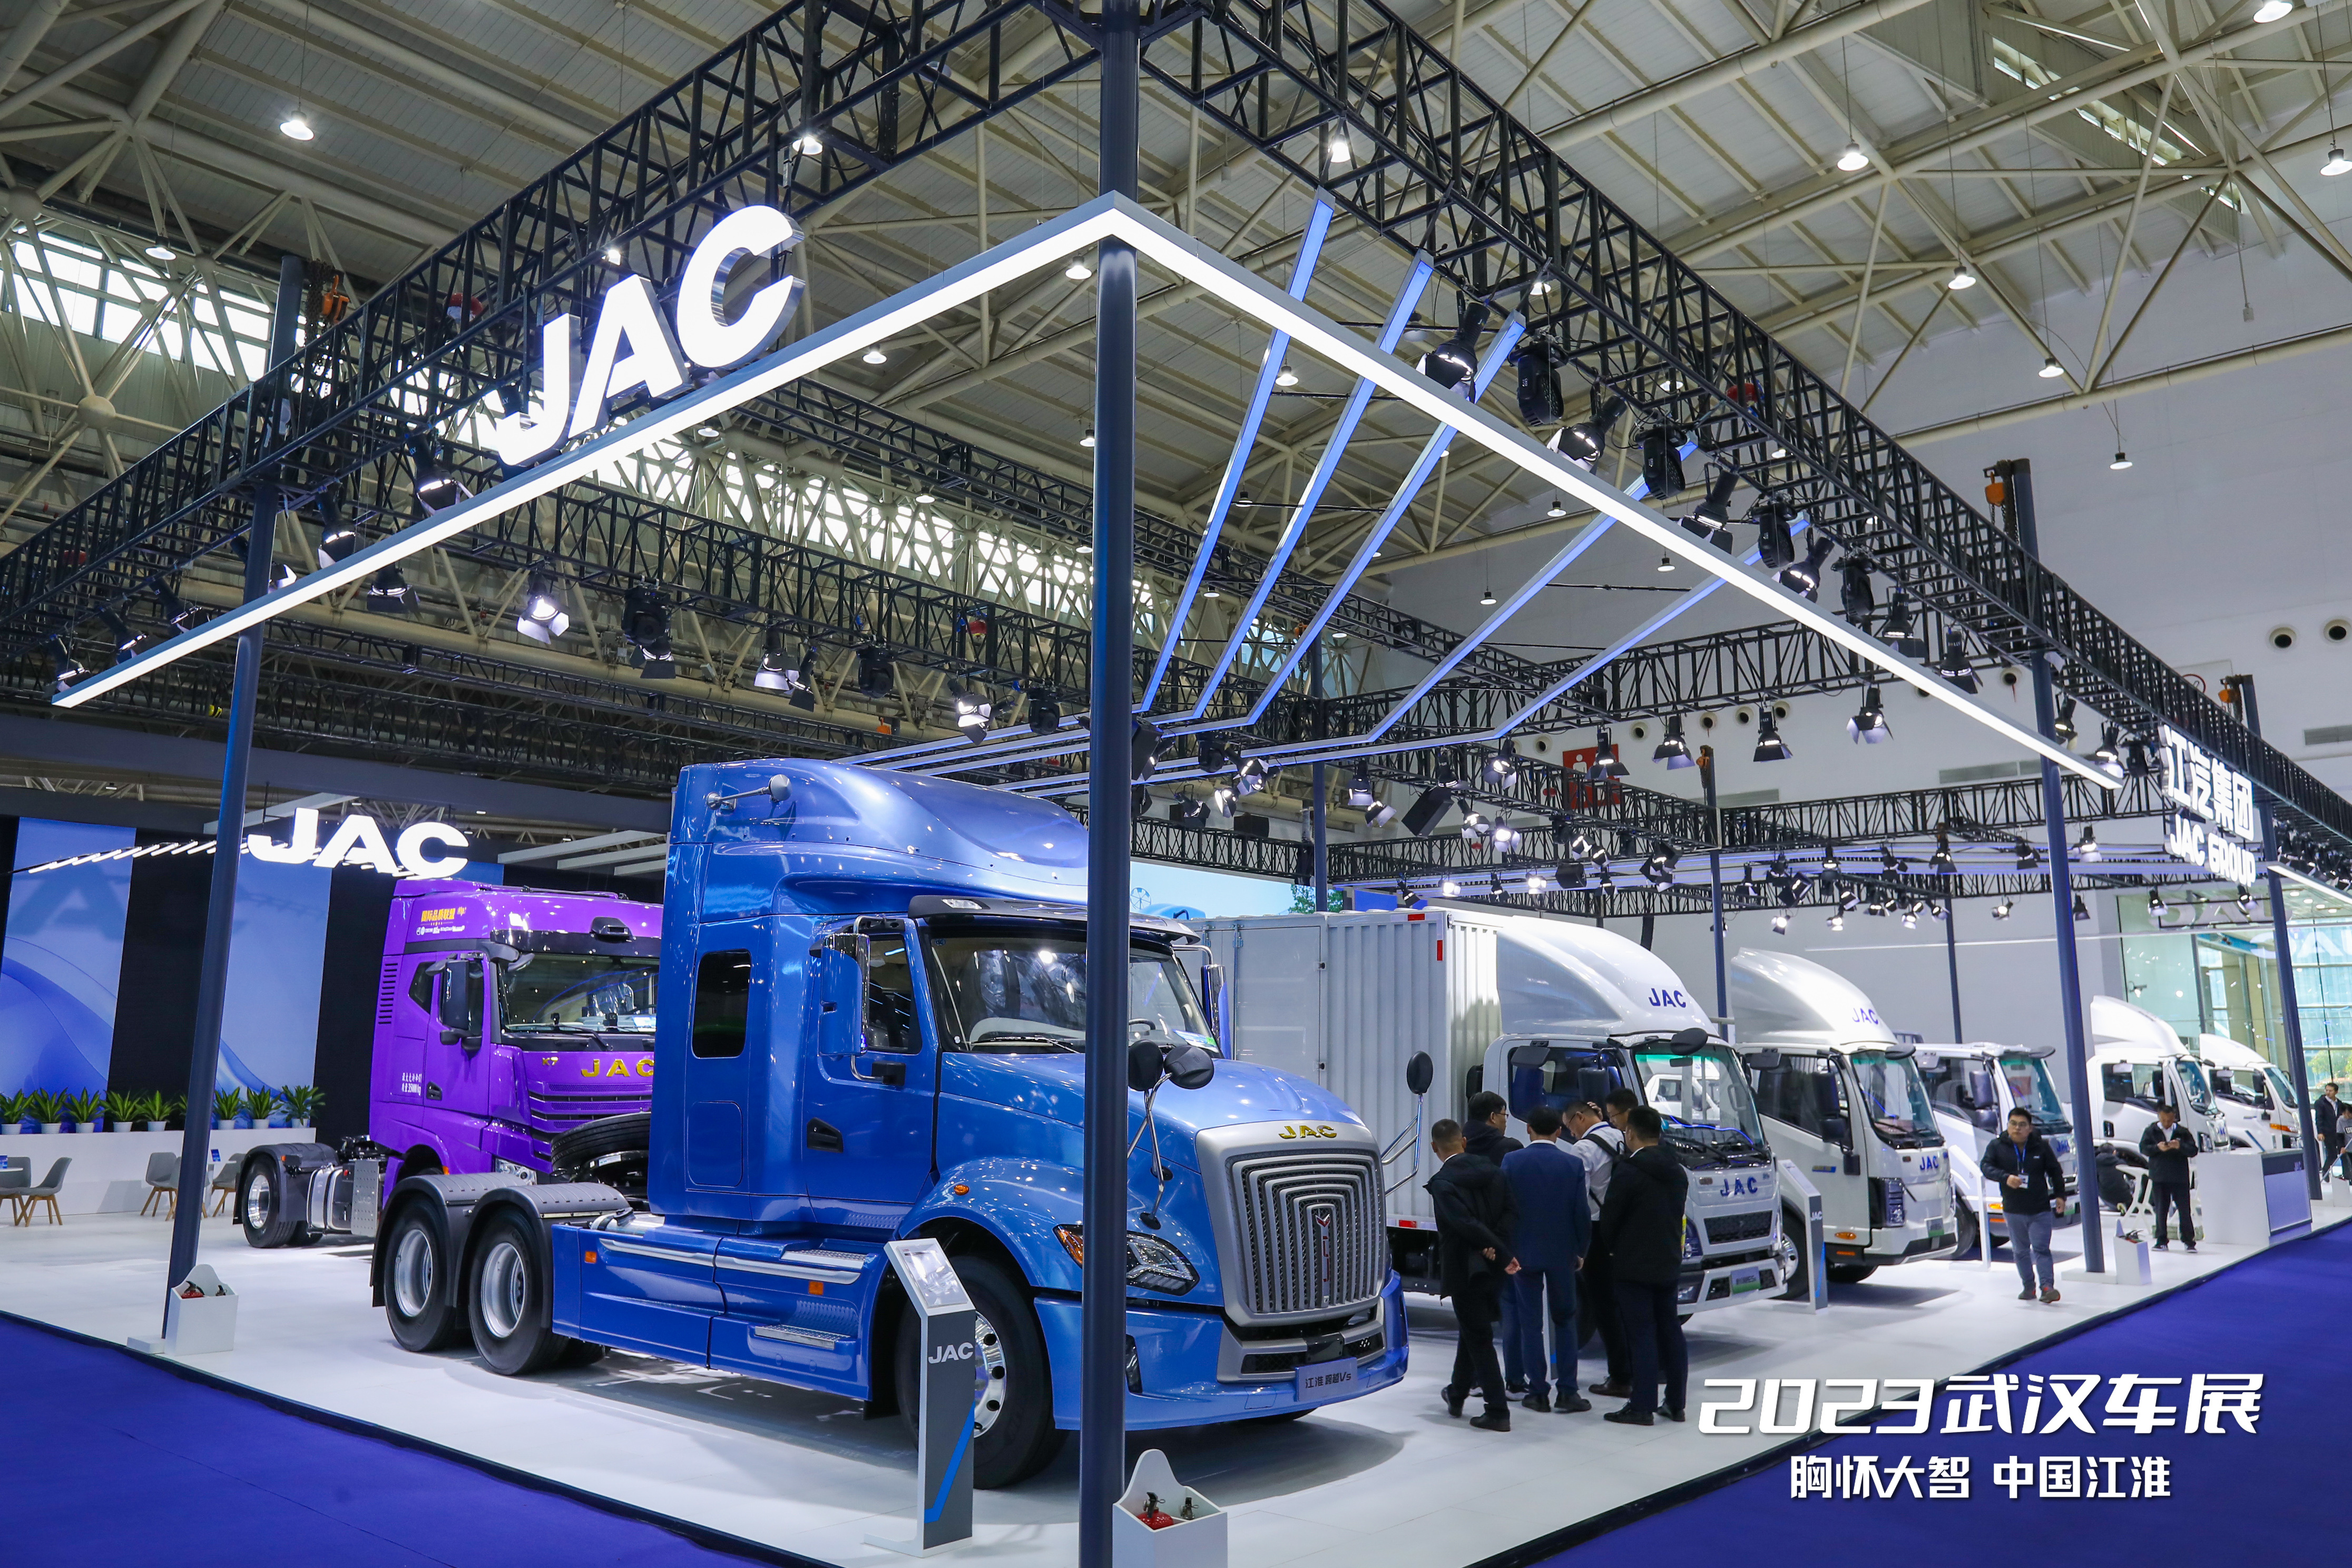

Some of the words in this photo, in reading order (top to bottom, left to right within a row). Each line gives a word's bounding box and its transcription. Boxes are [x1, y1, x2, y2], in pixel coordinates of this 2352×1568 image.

[496, 204, 805, 466] JAC
[2162, 724, 2255, 841] 江汽集团
[247, 807, 469, 879] JAC
[2170, 813, 2206, 867] JAC
[2208, 832, 2256, 888] GROUP
[1648, 988, 1687, 1008] JAC
[1852, 1007, 1878, 1024] JAC
[581, 1059, 654, 1077] JAC
[1278, 1125, 1337, 1139] JAC
[1919, 1155, 1939, 1171] JAC
[1720, 1177, 1758, 1197] JAC
[1810, 1211, 1822, 1221] JAC
[928, 1342, 974, 1364] JAC
[1305, 1376, 1324, 1388] 江淮
